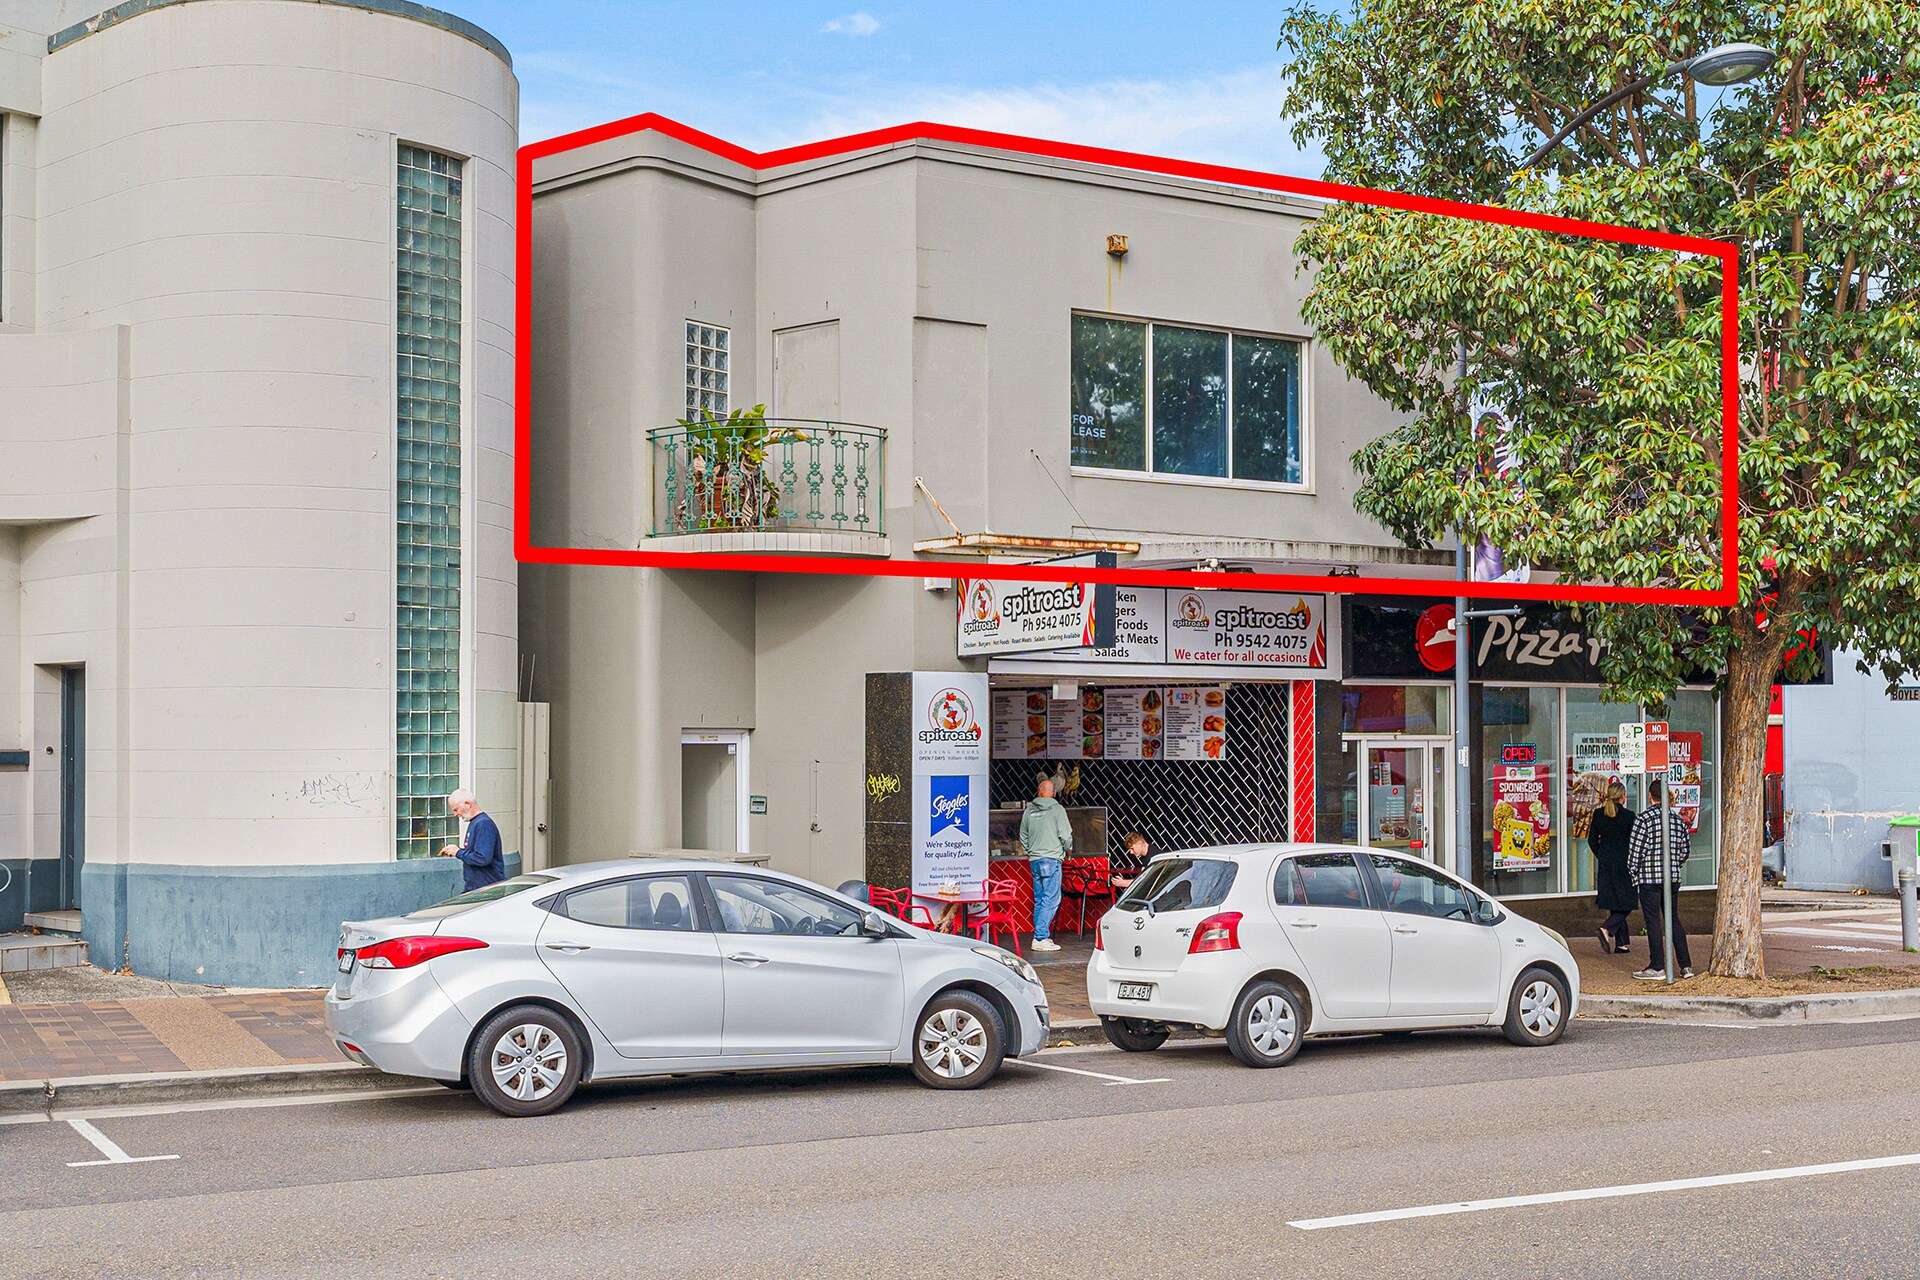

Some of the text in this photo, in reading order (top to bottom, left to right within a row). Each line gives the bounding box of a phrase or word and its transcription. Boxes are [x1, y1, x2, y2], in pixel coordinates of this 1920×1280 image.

[1072, 414, 1094, 425] FOR
[1072, 426, 1106, 438] LEASE
[1003, 582, 1081, 622] spitroast
[1115, 607, 1136, 618] gers
[1022, 612, 1081, 632] Ph 9542 4075
[1117, 619, 1149, 630] Foods
[1173, 618, 1209, 628] spitroast
[1215, 606, 1307, 632] spitroast
[964, 618, 999, 635] spitroast
[1127, 633, 1159, 645] Meats
[1215, 633, 1307, 649] Ph 9542 4075
[1477, 615, 1583, 667] Pizza
[1095, 647, 1130, 658] Salads
[1174, 649, 1308, 663] We cater for all occasions
[1893, 690, 1918, 700] BOYLE
[1634, 726, 1643, 738] P
[1652, 724, 1662, 733] NO
[919, 728, 980, 744] spitroast
[1503, 747, 1535, 760] OPEN
[1576, 744, 1619, 758] LOADED COOK
[1499, 782, 1543, 793] SPONGEBOB
[931, 793, 969, 819] Steggles
[945, 840, 972, 849] Stegglers
[934, 851, 957, 859] quality
[957, 850, 975, 858] time
